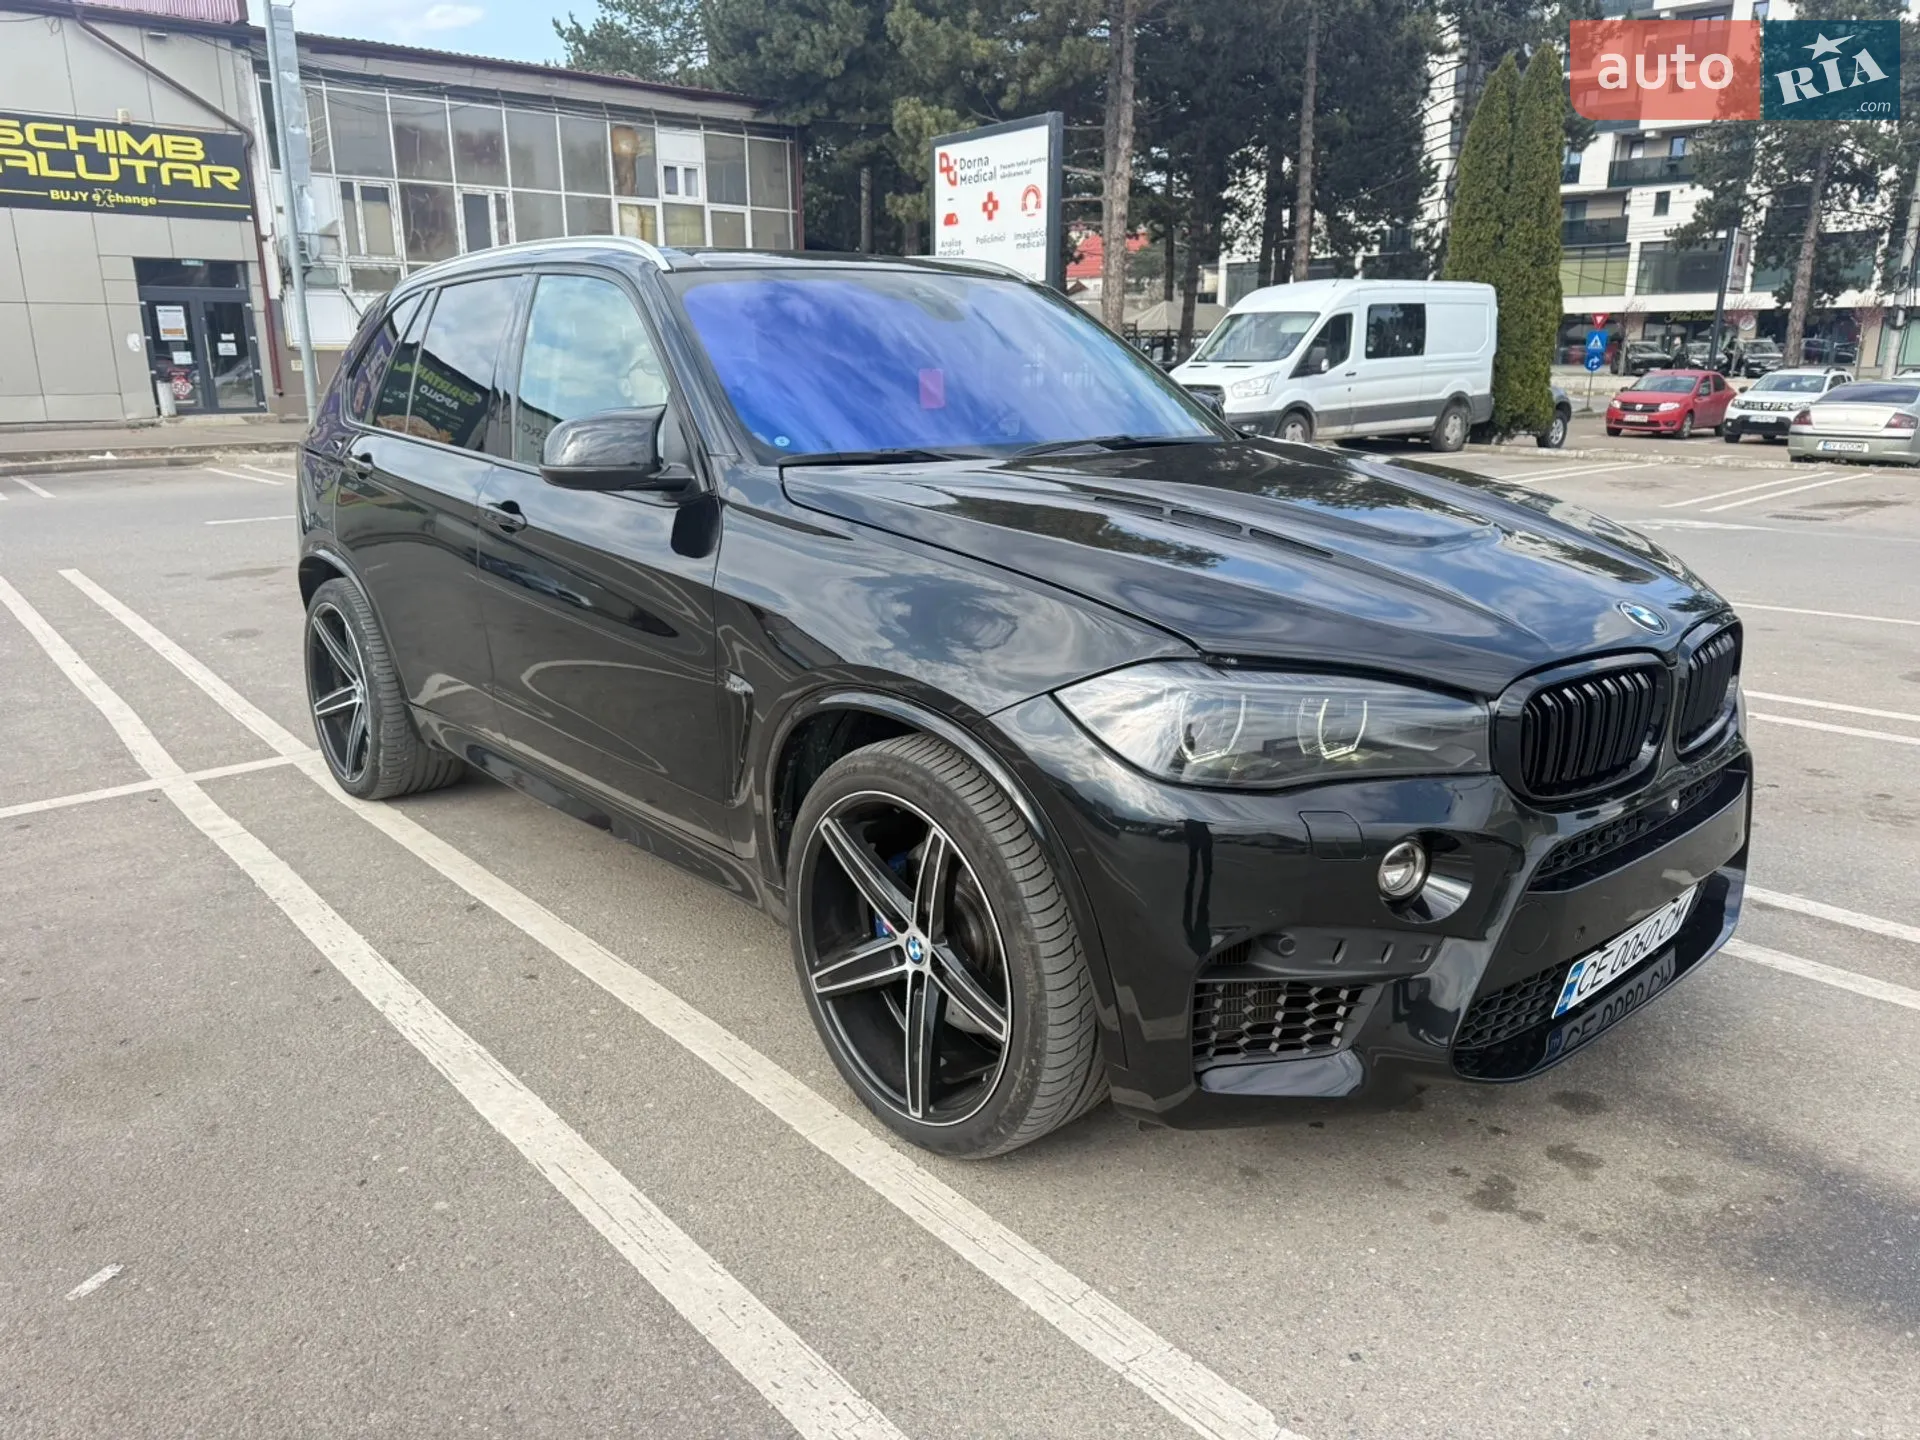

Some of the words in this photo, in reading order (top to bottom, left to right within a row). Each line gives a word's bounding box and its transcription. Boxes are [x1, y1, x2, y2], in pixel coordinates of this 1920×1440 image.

[959, 155, 990, 171] Dorna
[959, 166, 998, 187] Medical
[49, 189, 88, 202] BUJY
[1577, 949, 1613, 997] CE
[1610, 917, 1660, 975] 0060
